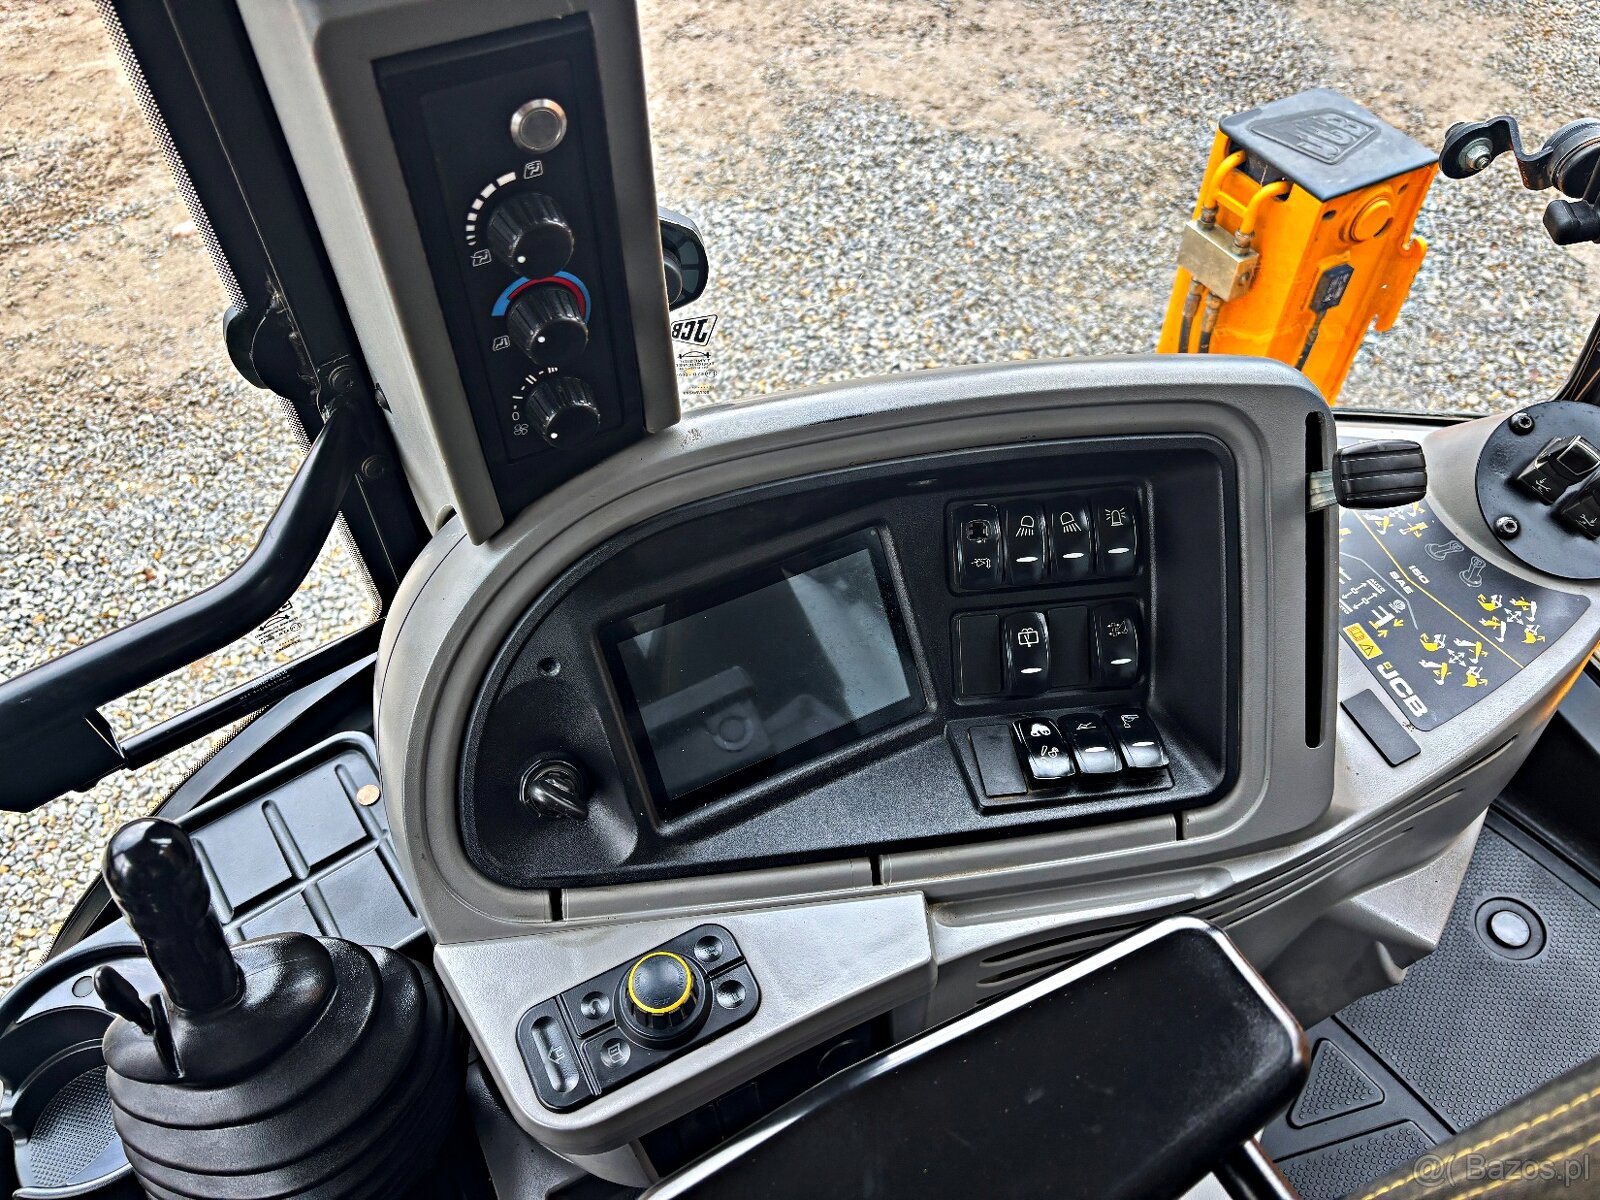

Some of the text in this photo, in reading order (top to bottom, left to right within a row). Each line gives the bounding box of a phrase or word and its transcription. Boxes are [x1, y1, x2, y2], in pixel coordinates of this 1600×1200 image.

[1296, 113, 1370, 158] JCB
[1389, 570, 1414, 595] SAE
[1408, 565, 1430, 584] ISO
[1376, 662, 1429, 718] JCB
